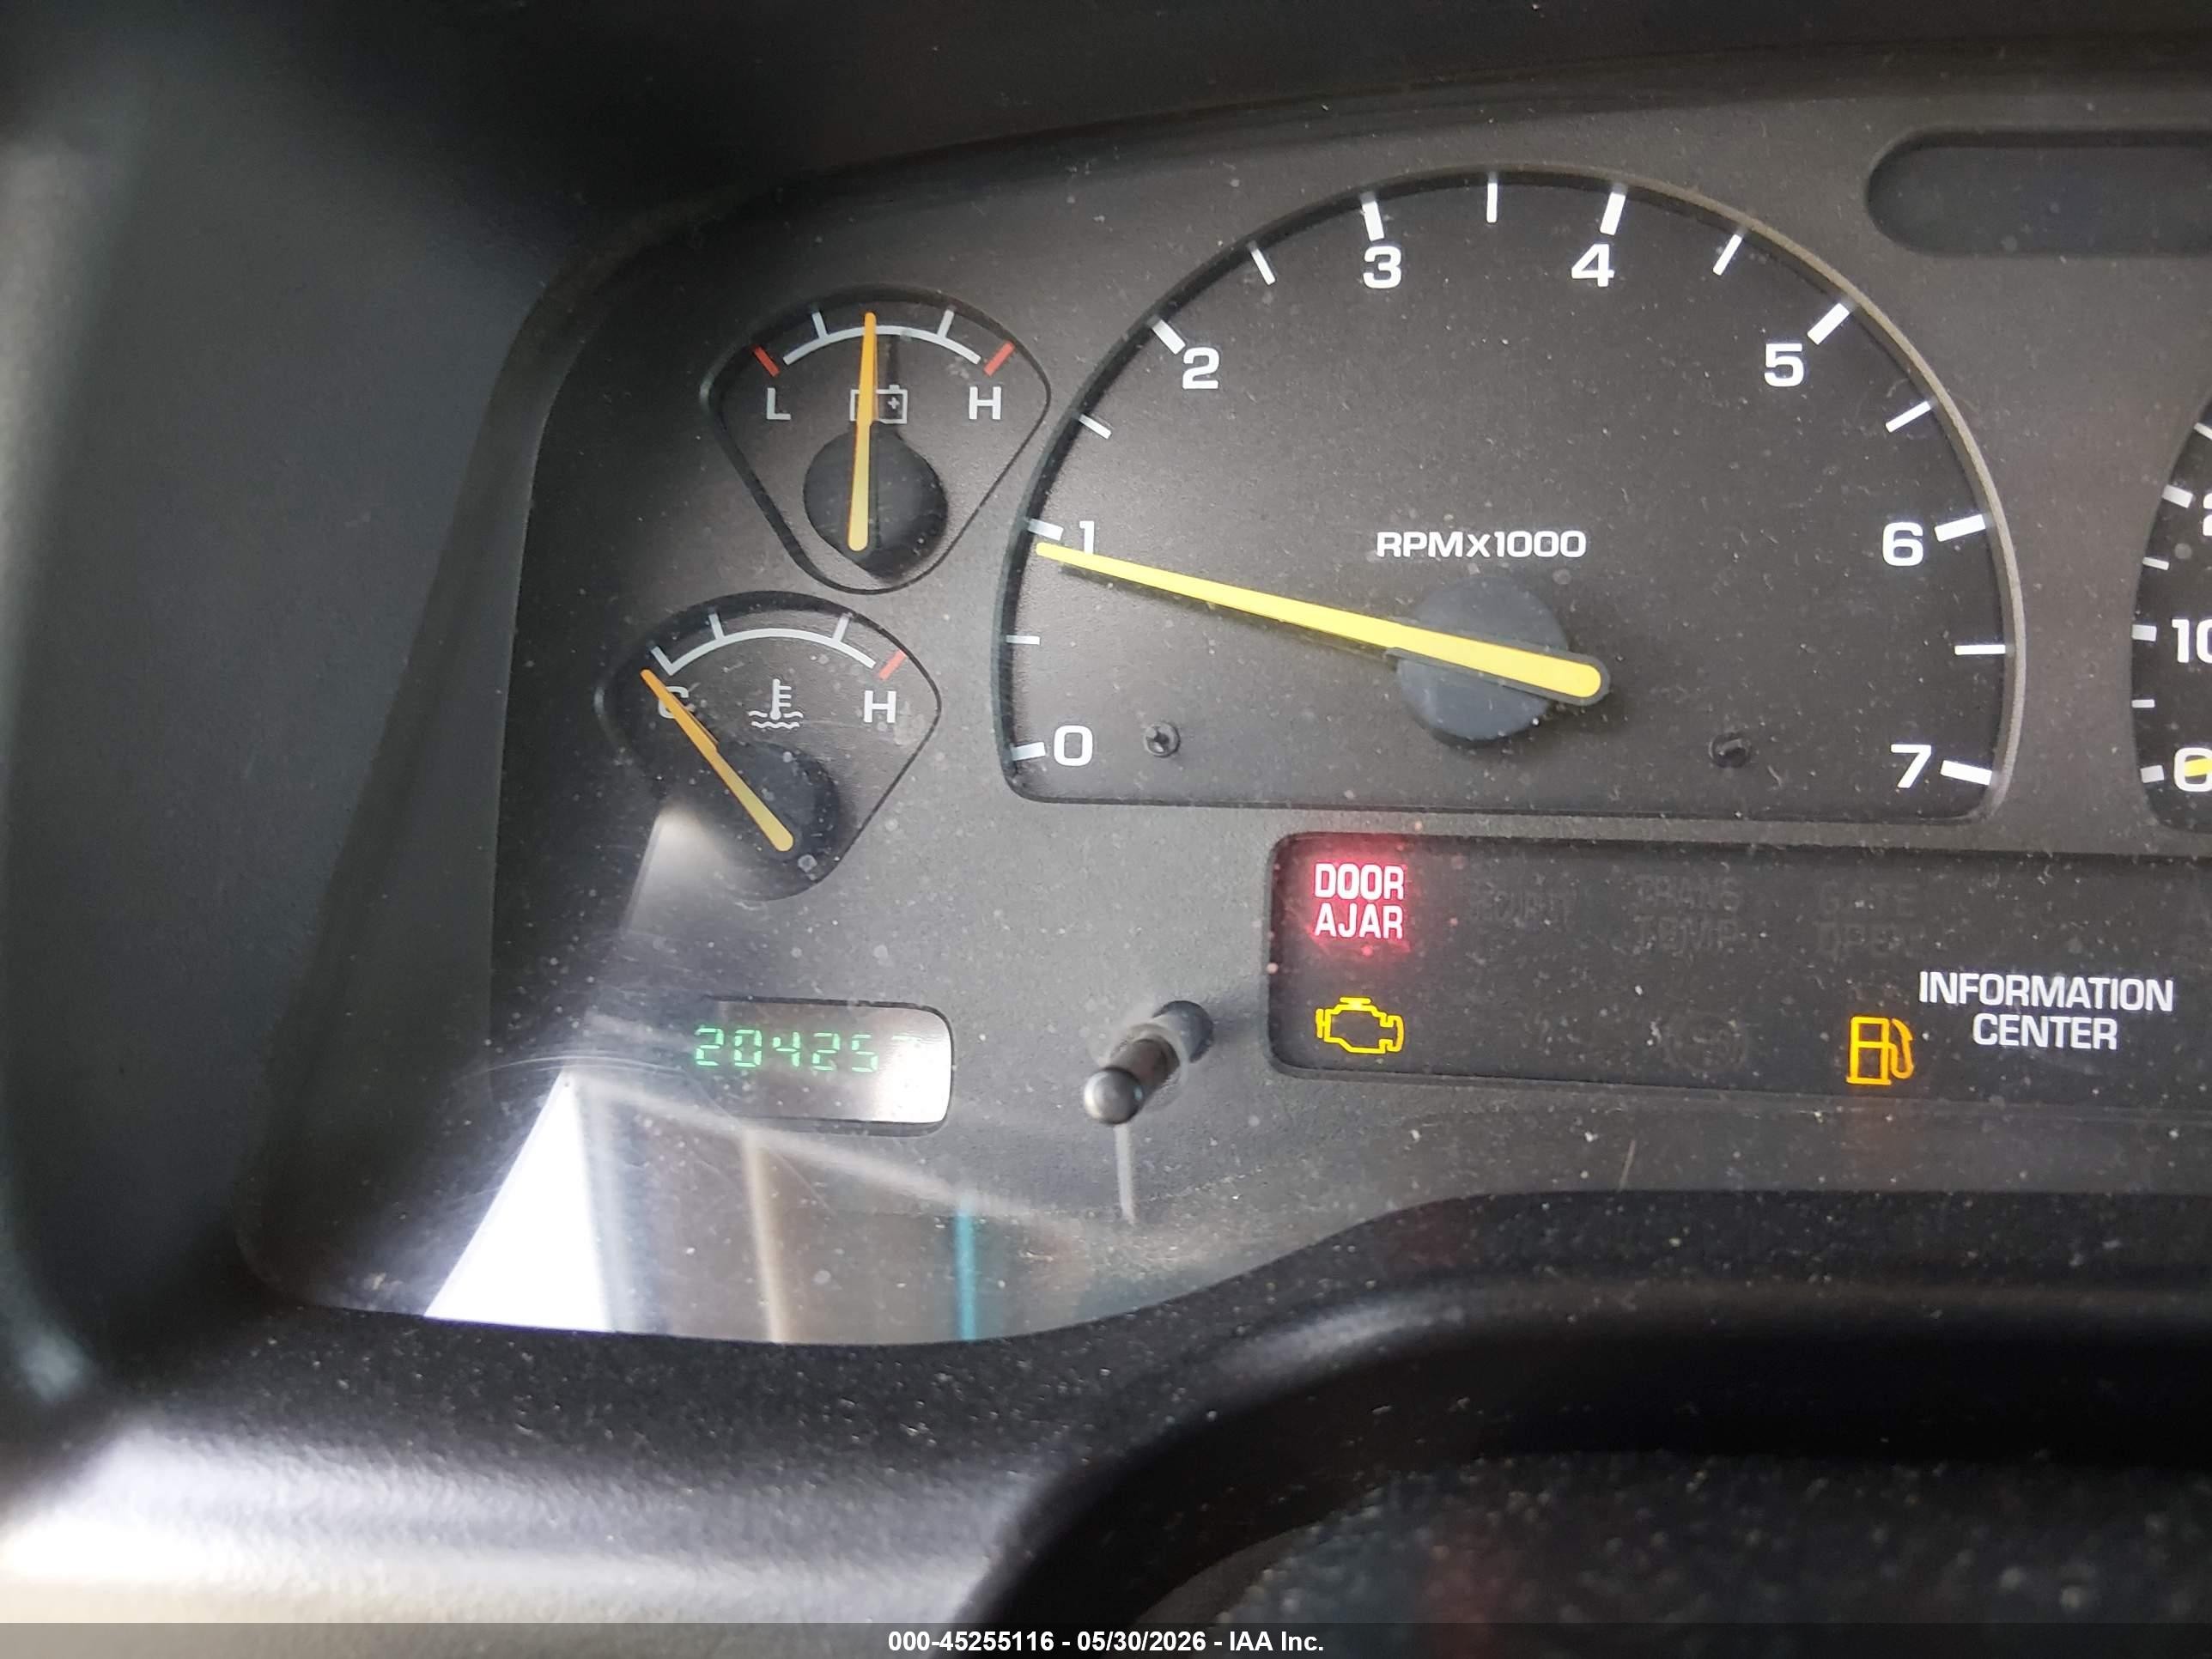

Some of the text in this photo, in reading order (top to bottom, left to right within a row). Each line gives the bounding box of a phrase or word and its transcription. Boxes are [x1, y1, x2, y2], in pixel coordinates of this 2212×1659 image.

[1364, 246, 1401, 289] 3
[1571, 243, 1614, 288] 4
[1182, 346, 1219, 389] 2
[1764, 343, 1804, 387] 5
[766, 387, 792, 421] L
[969, 386, 1002, 421] H
[1079, 520, 1095, 555] 1
[1882, 522, 1923, 567] 6
[863, 690, 897, 724] H
[1054, 725, 1093, 767] 0
[1891, 744, 1932, 788] 7
[1315, 863, 1404, 900] DOOR
[1315, 902, 1403, 939] AJAR
[1919, 970, 2174, 1012] INFORMATION
[1973, 1013, 2118, 1050] CENTER
